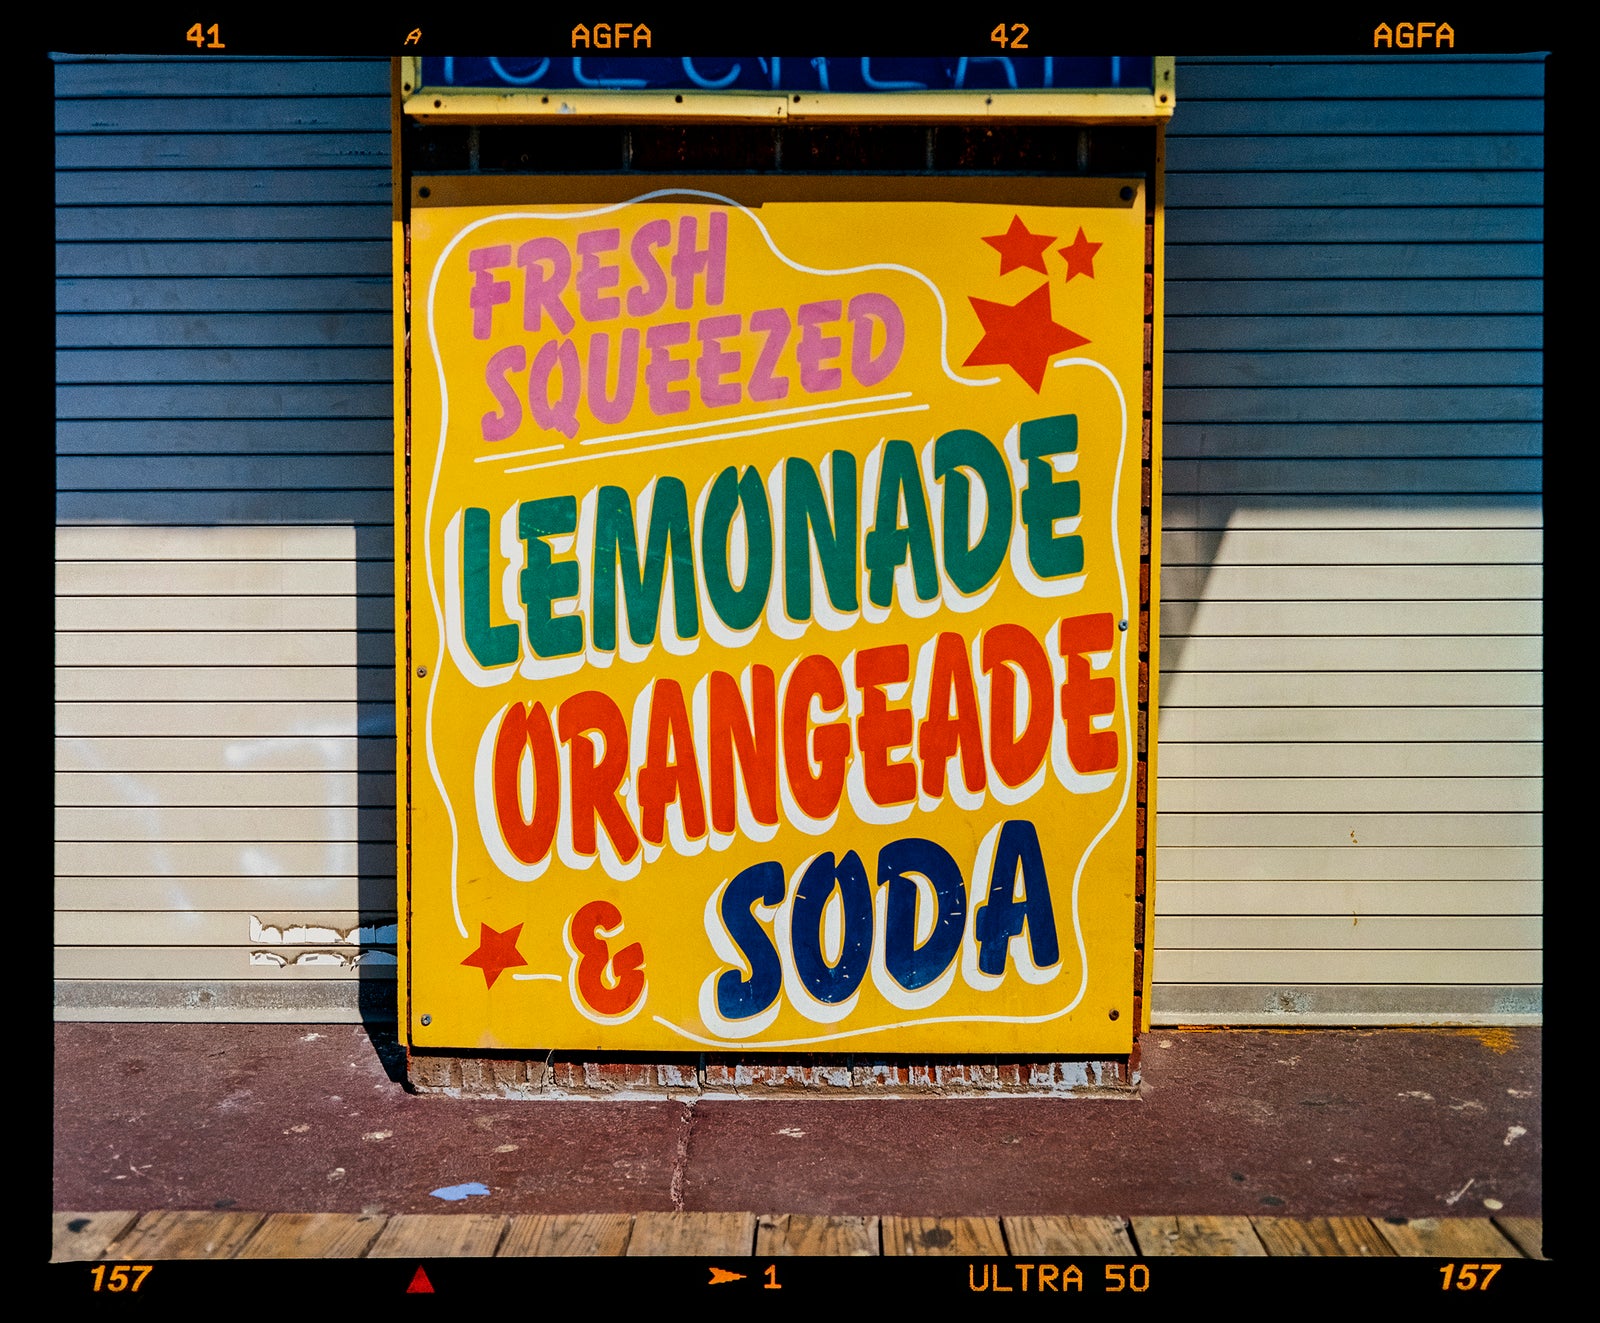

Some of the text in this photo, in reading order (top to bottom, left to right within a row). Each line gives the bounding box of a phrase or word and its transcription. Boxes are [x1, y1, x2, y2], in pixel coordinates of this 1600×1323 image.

[468, 211, 729, 340] FRESH
[481, 293, 905, 442] SQUEEZED
[450, 414, 1086, 682] LEMONADE
[480, 613, 1119, 876] ORANGEADE
[565, 820, 1060, 1032] & SODA
